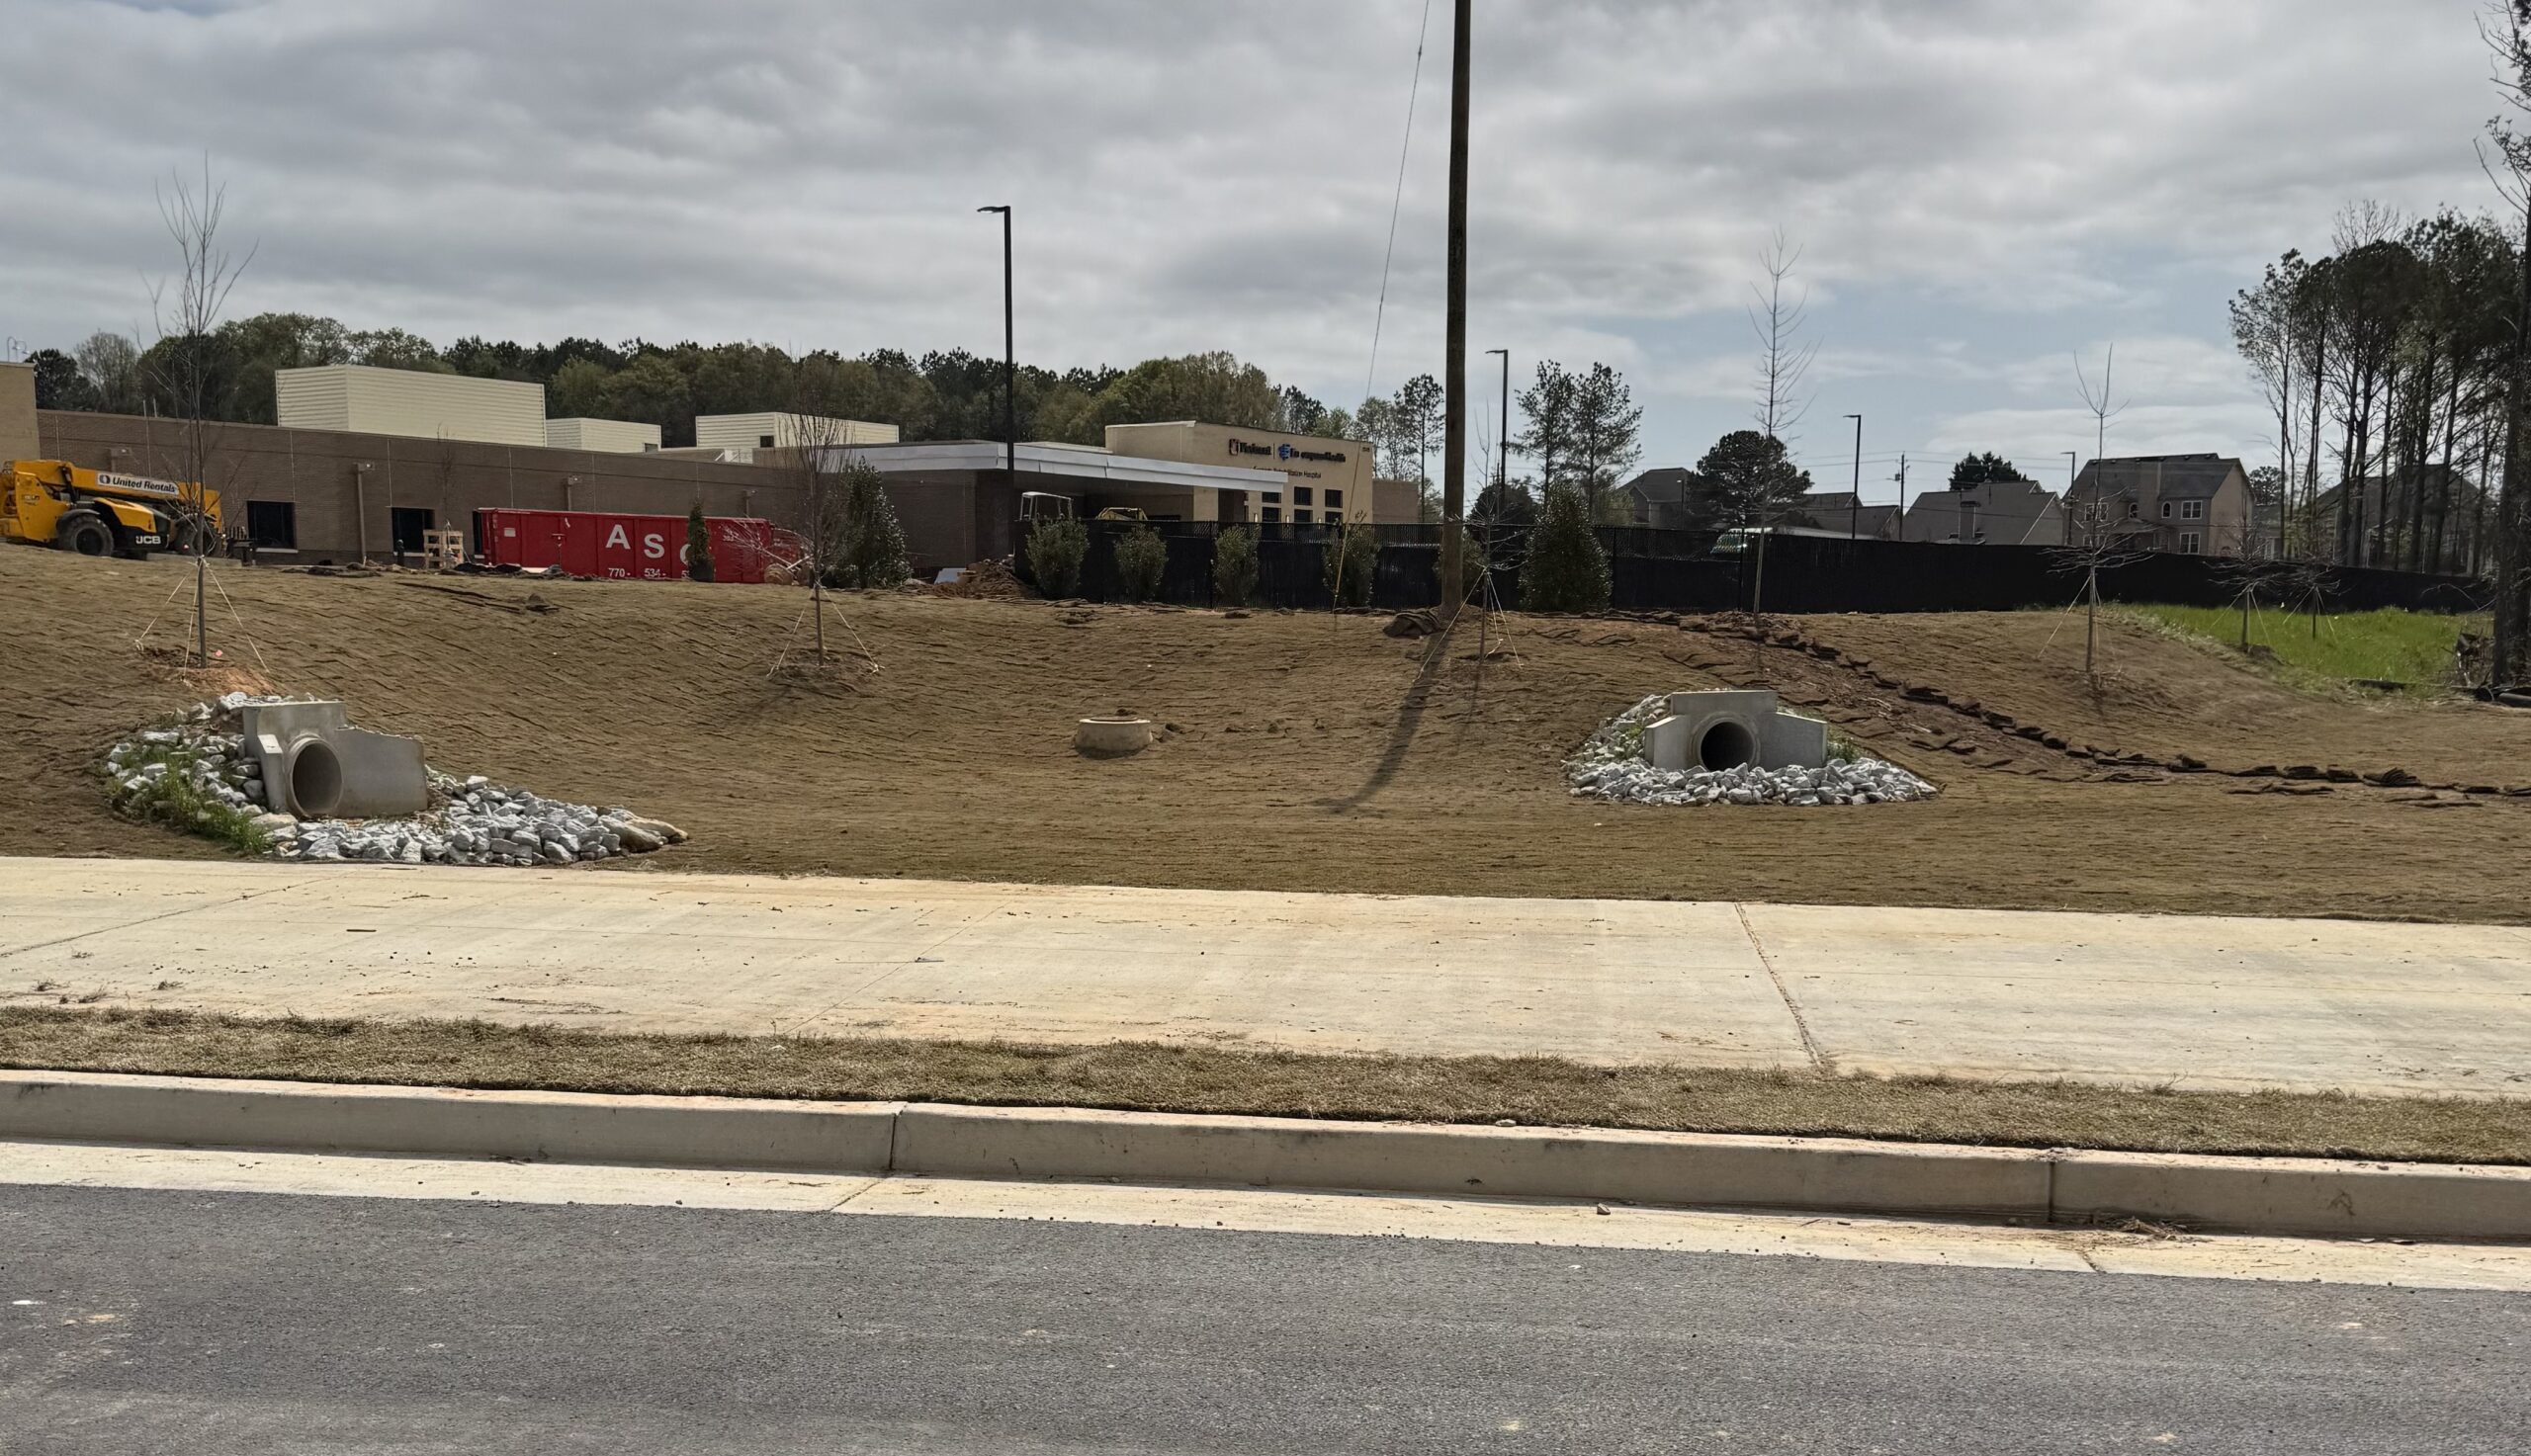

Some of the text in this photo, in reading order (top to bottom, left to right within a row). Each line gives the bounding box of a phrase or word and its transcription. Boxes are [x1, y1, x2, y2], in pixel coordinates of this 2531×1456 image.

[113, 476, 176, 493] United Rentals
[135, 535, 161, 545] JCB
